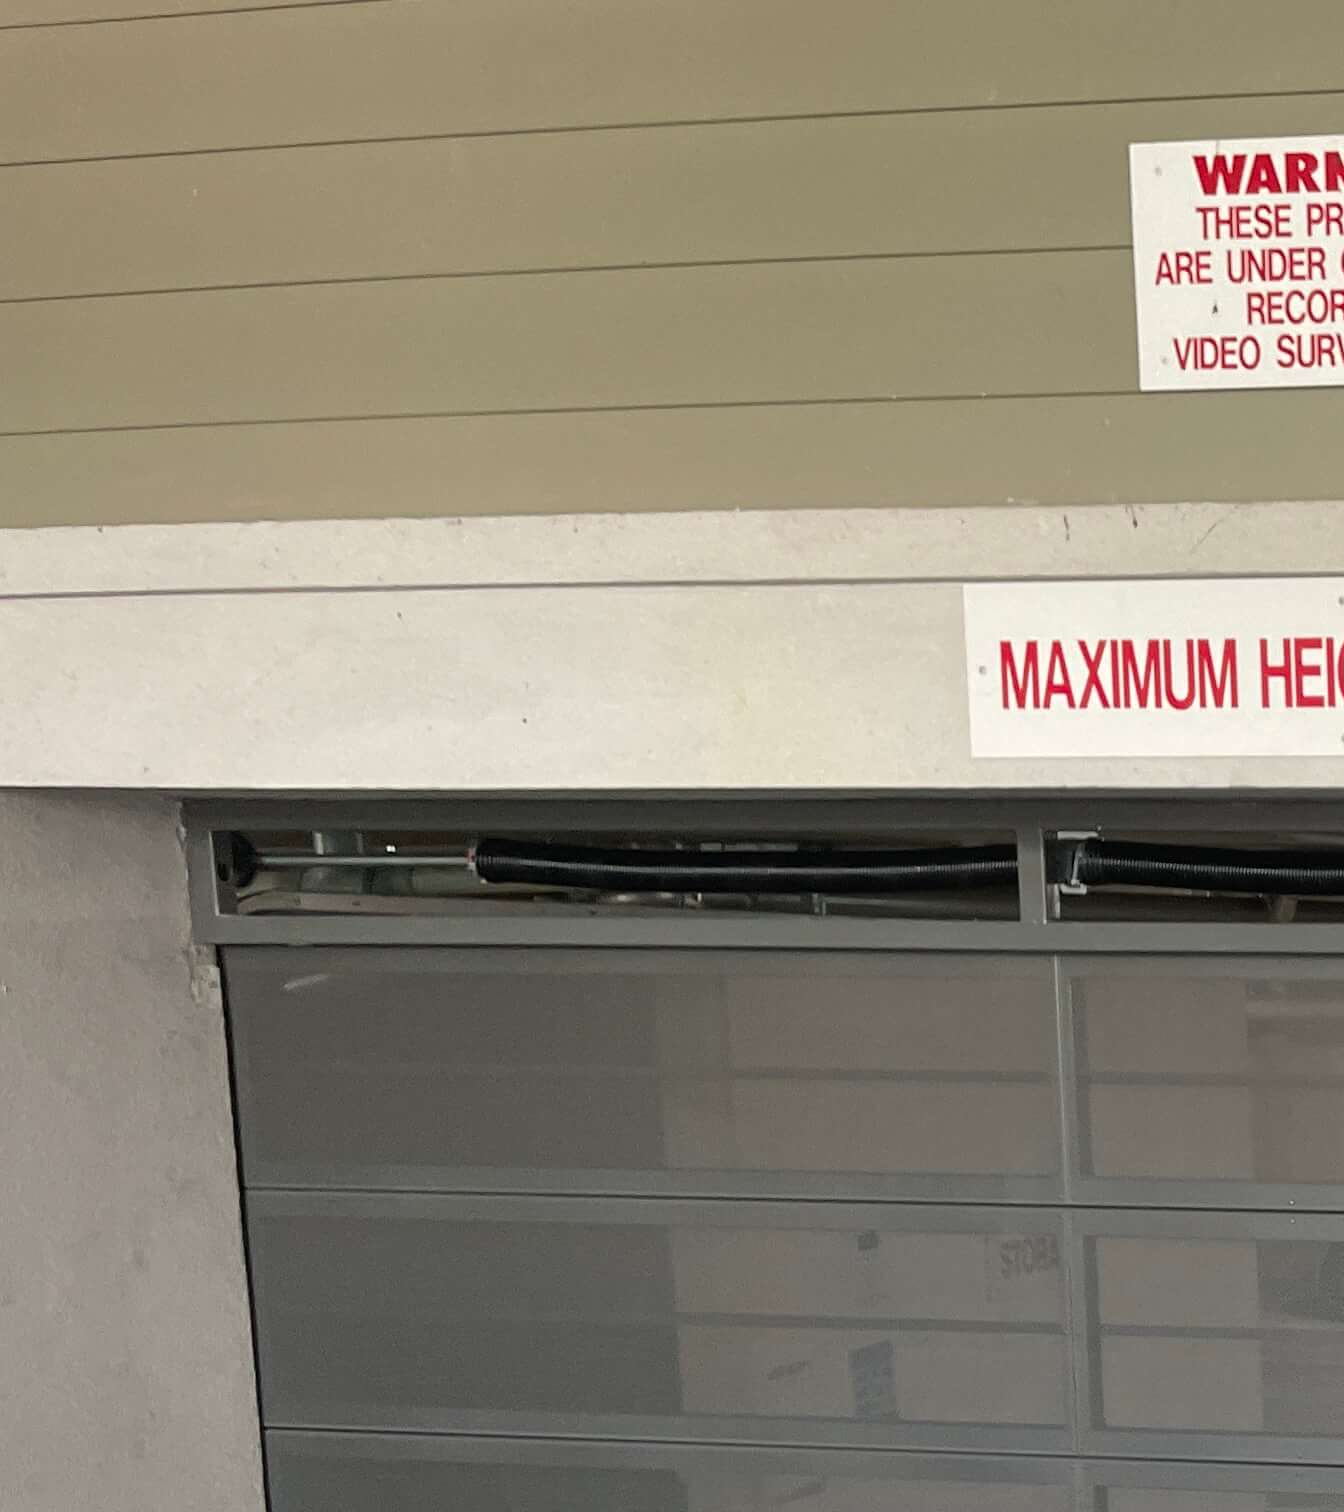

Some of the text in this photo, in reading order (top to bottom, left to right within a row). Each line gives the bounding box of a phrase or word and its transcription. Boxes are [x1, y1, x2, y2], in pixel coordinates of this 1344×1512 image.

[1196, 204, 1291, 240] THESE
[1155, 251, 1211, 285] ARE
[1227, 247, 1327, 284] UNDER
[1173, 336, 1261, 370] VIDEO
[999, 638, 1239, 711] MAXIMUM
